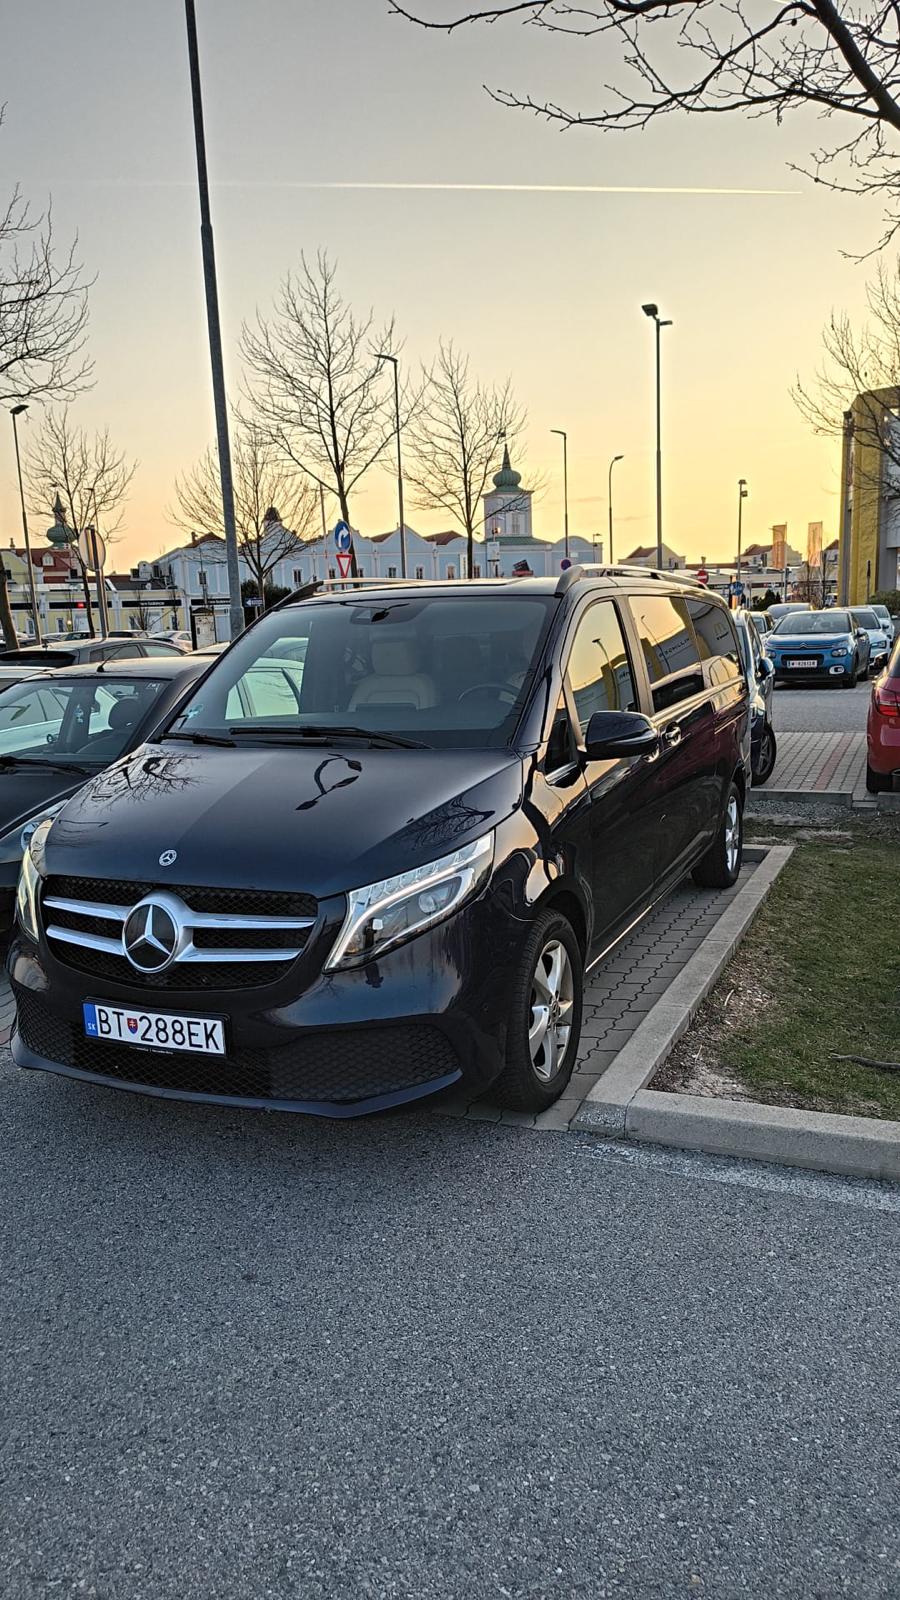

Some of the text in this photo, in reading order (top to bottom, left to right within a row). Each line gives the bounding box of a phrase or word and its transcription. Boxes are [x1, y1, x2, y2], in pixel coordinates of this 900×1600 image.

[87, 1022, 96, 1031] SK
[98, 1008, 220, 1050] BT 288EK
